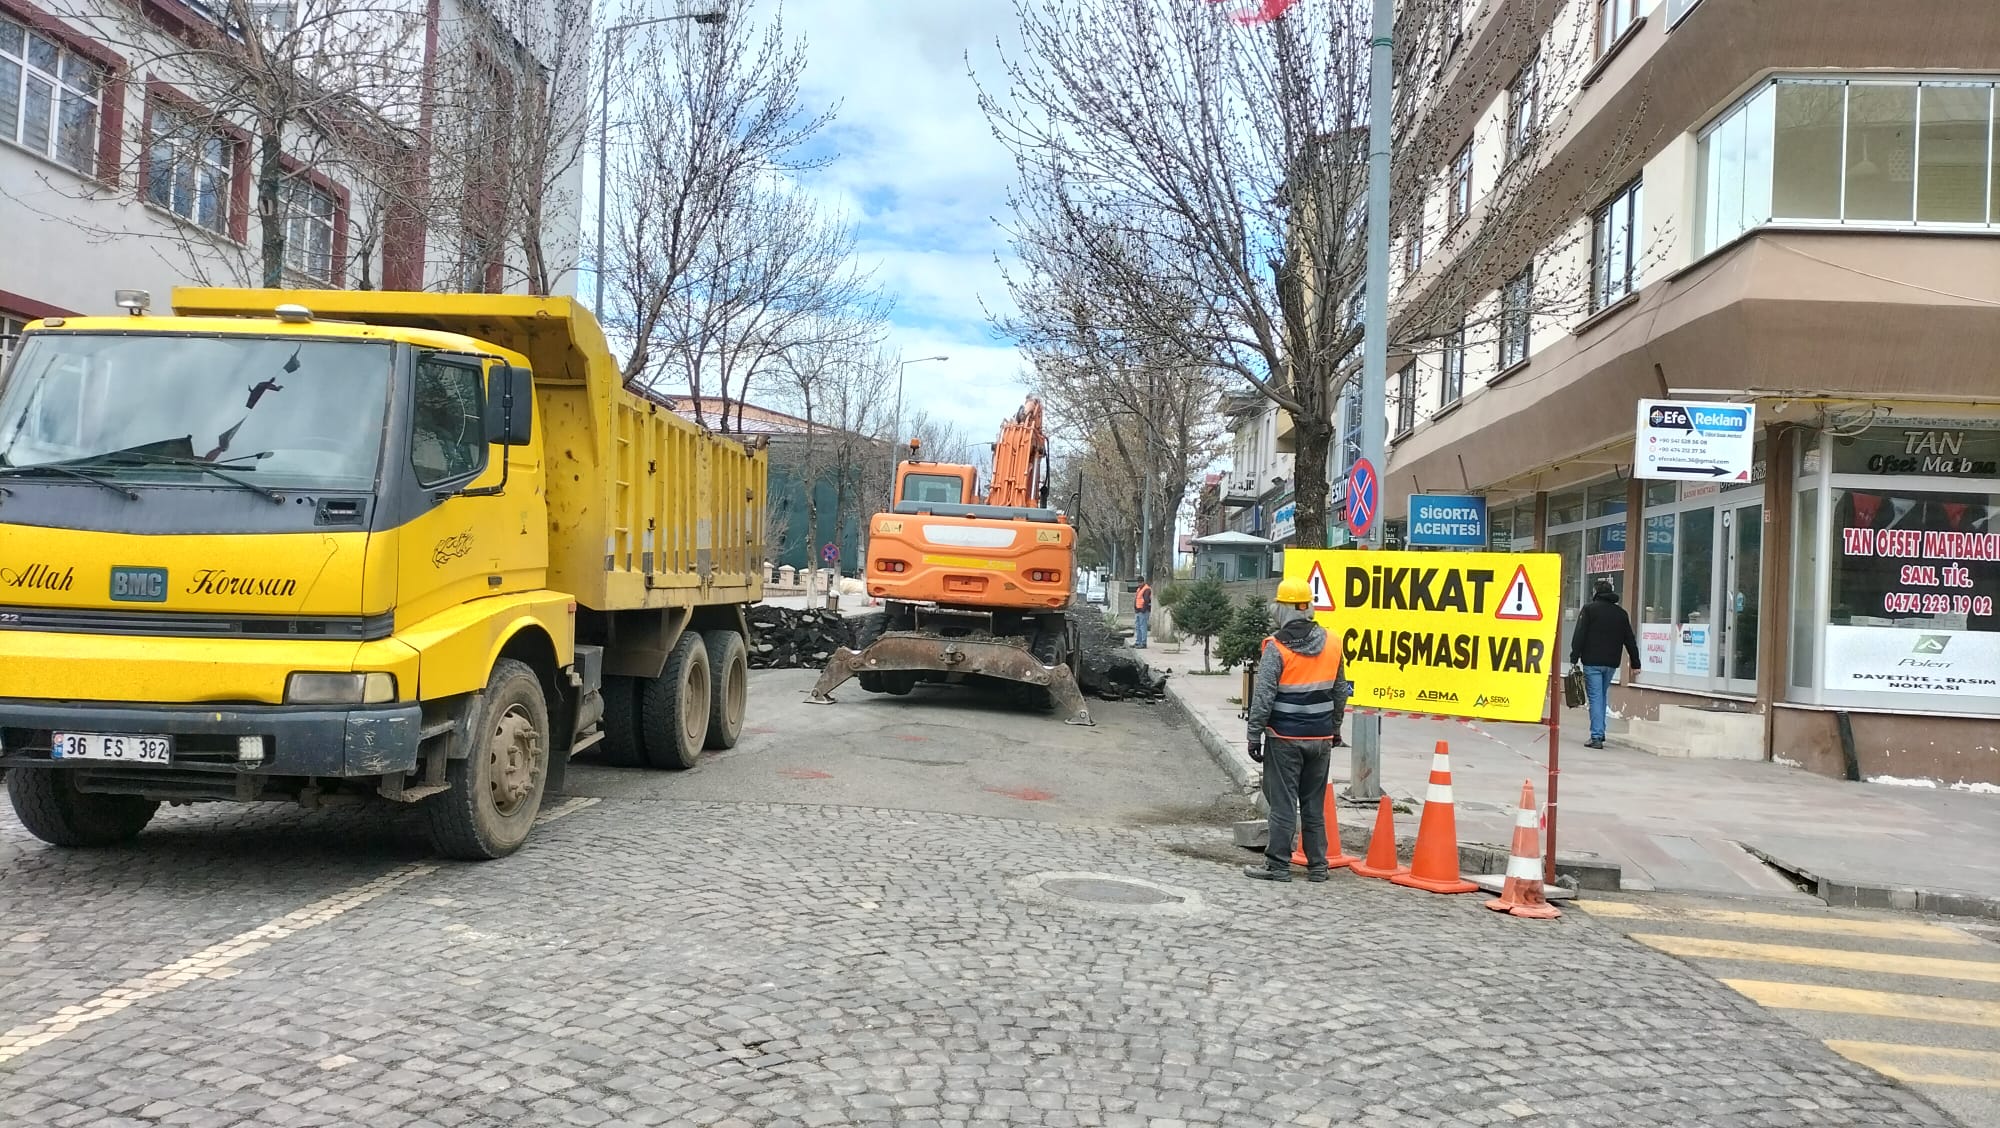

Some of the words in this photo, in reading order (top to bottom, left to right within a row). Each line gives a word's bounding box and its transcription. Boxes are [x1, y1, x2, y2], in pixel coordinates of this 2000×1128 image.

[1664, 411, 1687, 425] Efe
[1695, 412, 1743, 427] Reklam
[1903, 431, 1965, 455] TAN
[1868, 454, 1918, 474] Ofset
[1420, 505, 1479, 521] SİGORTA
[1414, 521, 1481, 537] ACENTESİ
[1843, 528, 1874, 556] TAN
[1876, 528, 1921, 557] OFSET
[1922, 531, 2000, 562] MATBAACI
[0, 563, 75, 592] Allah
[114, 572, 162, 597] BMC
[185, 569, 298, 597] Korusun
[1900, 565, 1940, 586] SAN.
[1942, 562, 1974, 588] TİC.
[1884, 592, 1921, 613] 0474
[1922, 594, 1950, 613] 223
[1953, 595, 1971, 614] 19
[1973, 596, 1993, 616] 02
[1342, 627, 1480, 673] ÇALIŞMASI
[1488, 635, 1545, 674] VAR
[1898, 658, 1955, 669] Polen
[1852, 673, 1930, 683] DAVETİYE
[1946, 677, 1997, 686] BASIM
[1889, 682, 1961, 691] NOKTASI
[1373, 686, 1406, 700] eptisa
[1417, 689, 1459, 702] ABMA
[66, 736, 88, 756] 36
[103, 738, 125, 758] ES
[139, 740, 167, 760] 382
